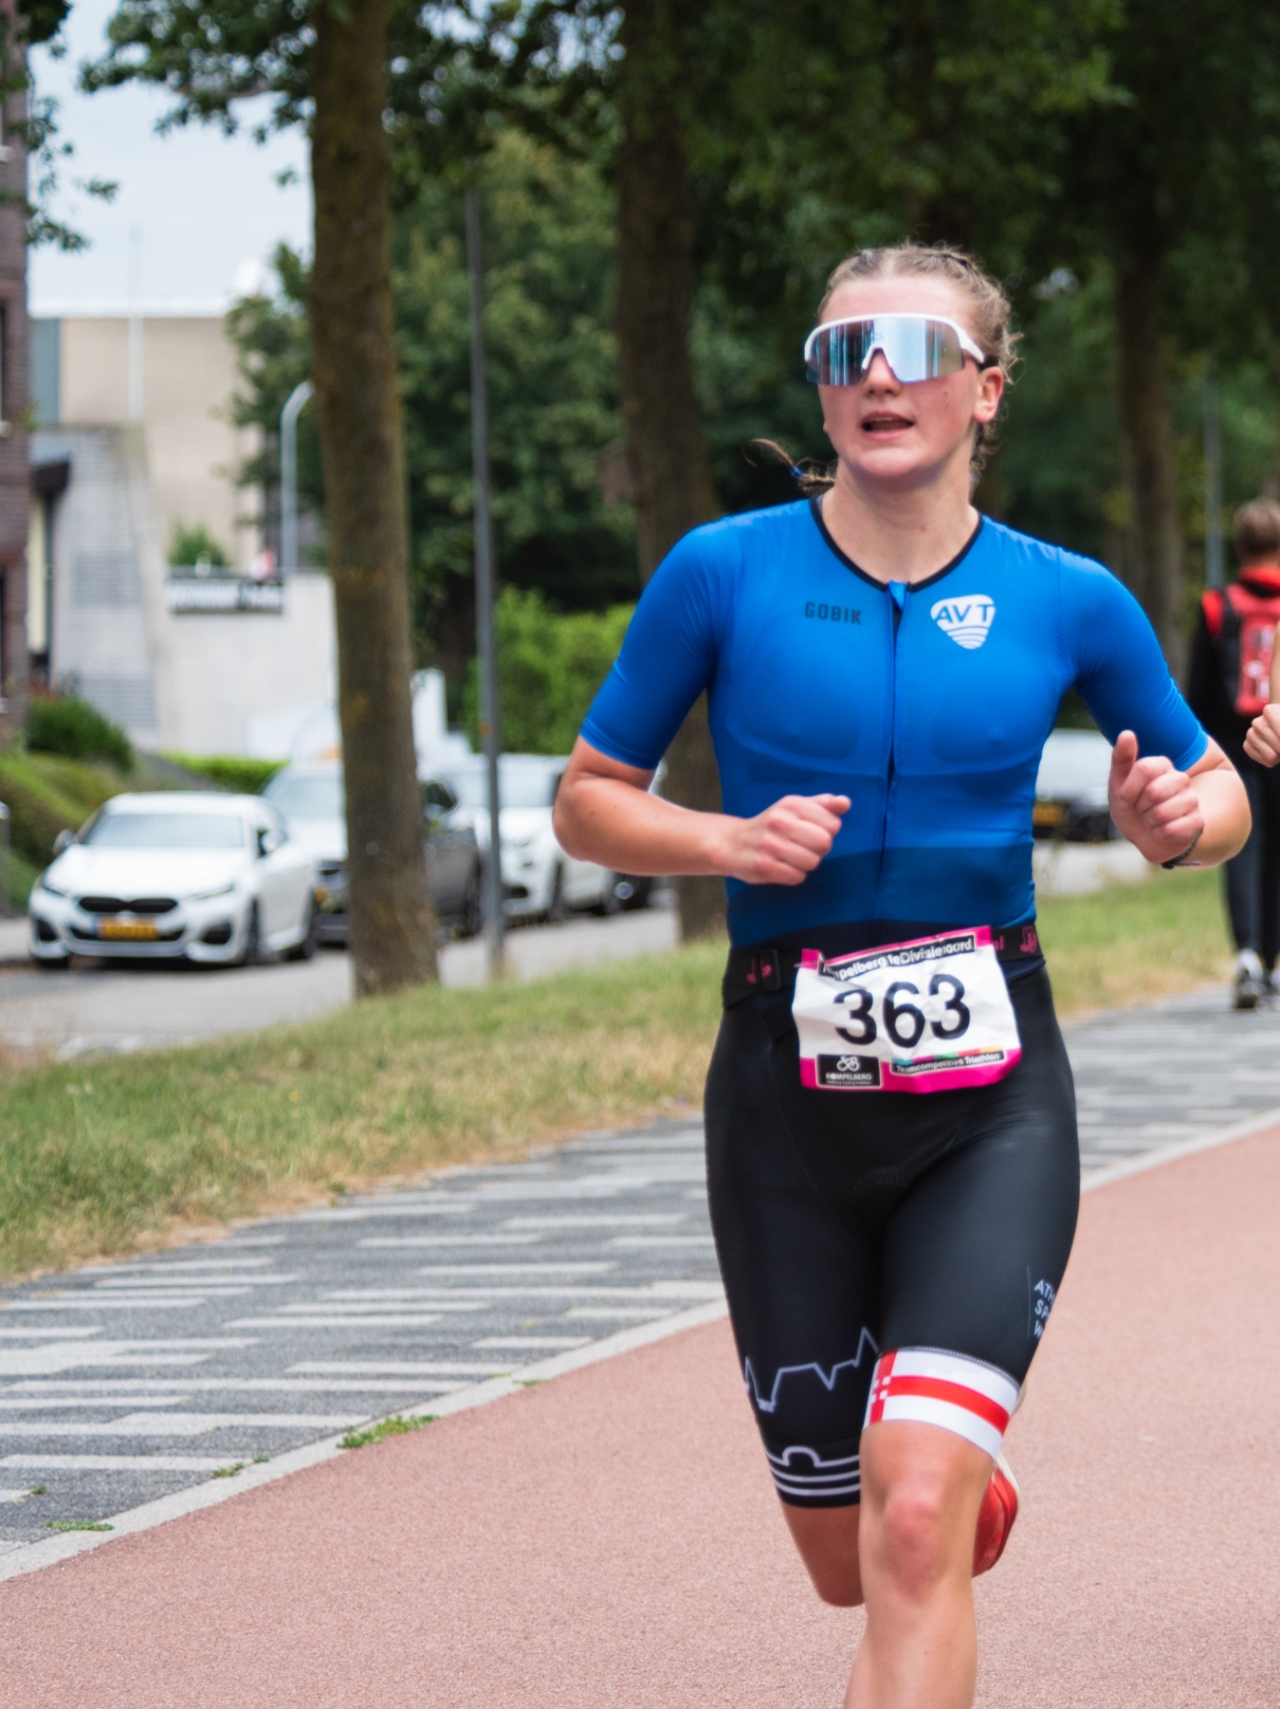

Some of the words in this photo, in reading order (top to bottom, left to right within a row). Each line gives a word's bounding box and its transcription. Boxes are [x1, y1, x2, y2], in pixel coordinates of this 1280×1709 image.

[804, 602, 861, 624] GOBIK
[934, 603, 996, 623] AVT
[833, 974, 971, 1048] 363
[964, 1052, 1000, 1066] Triathlon
